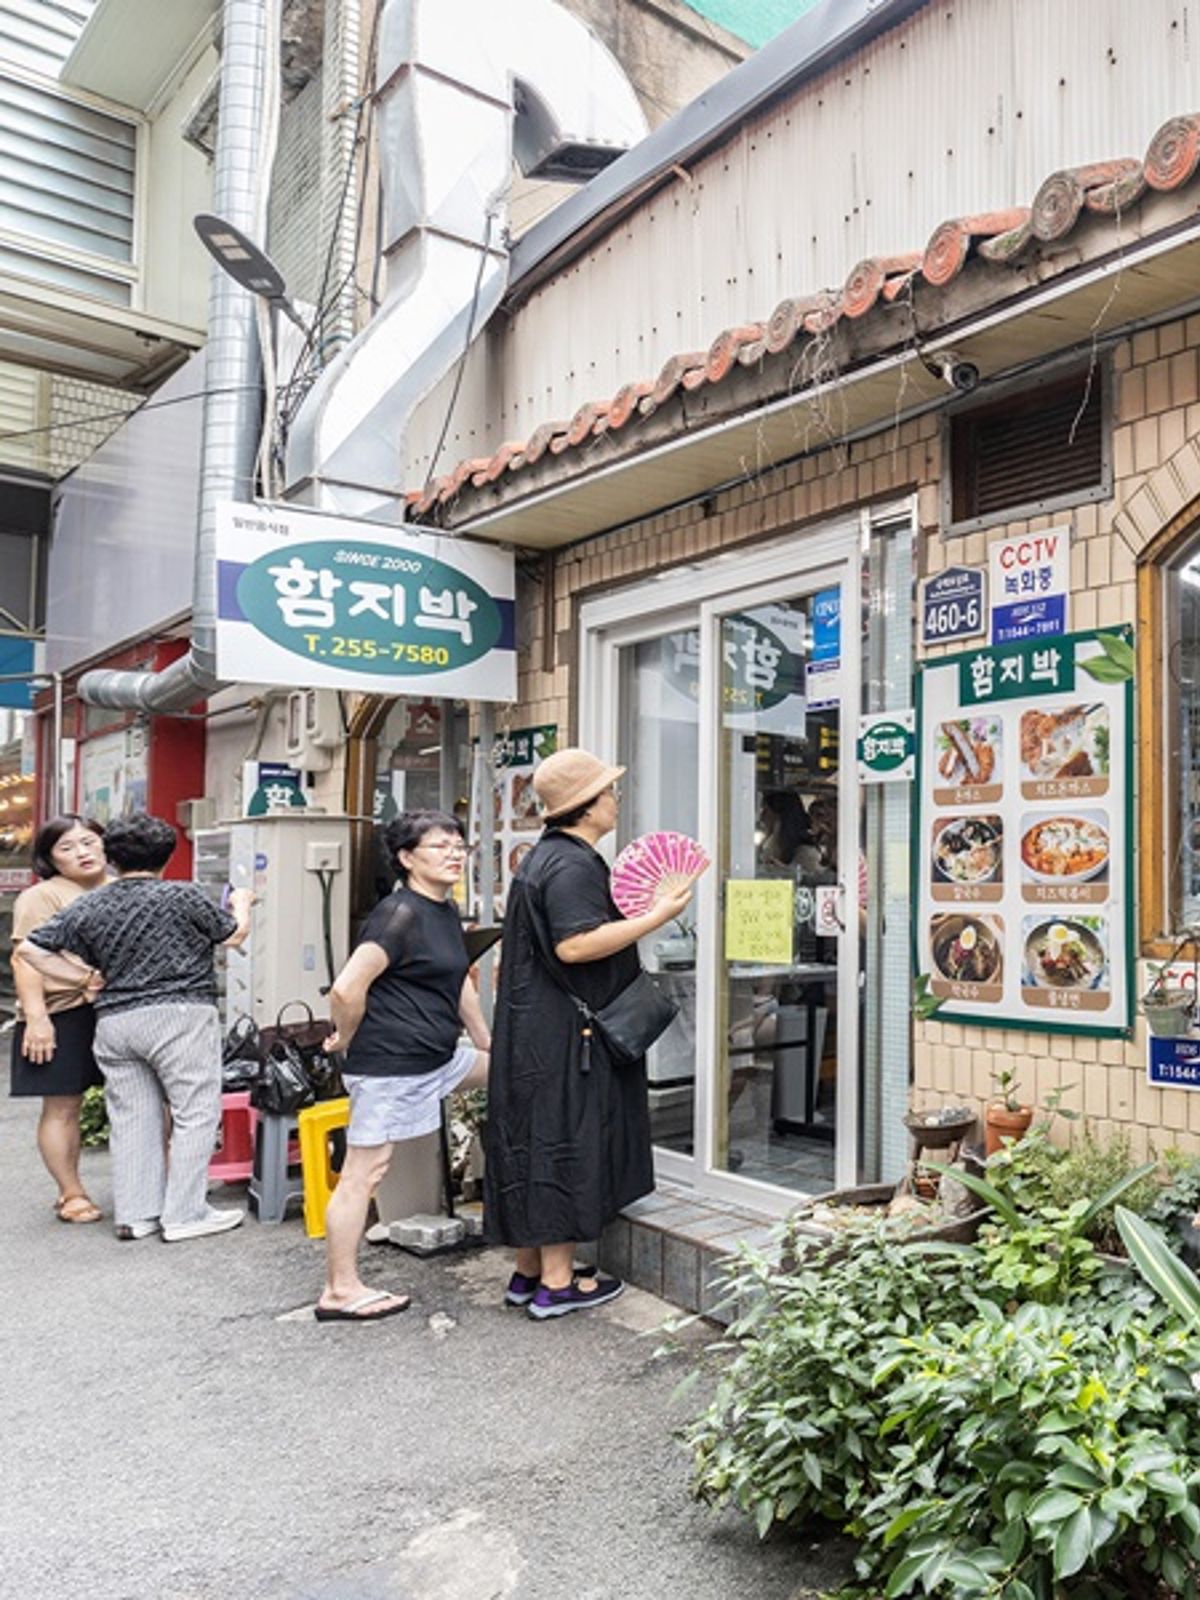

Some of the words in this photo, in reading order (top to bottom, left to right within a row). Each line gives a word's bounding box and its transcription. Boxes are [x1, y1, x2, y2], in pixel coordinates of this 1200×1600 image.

[332, 549, 381, 568] SINCE
[381, 556, 422, 575] 2000
[1000, 536, 1058, 569] CCTV
[267, 557, 478, 645] 함지박
[926, 599, 979, 634] 460-6
[303, 634, 326, 656] T.
[331, 637, 449, 665] 255-7580
[970, 648, 1061, 697] 함지박
